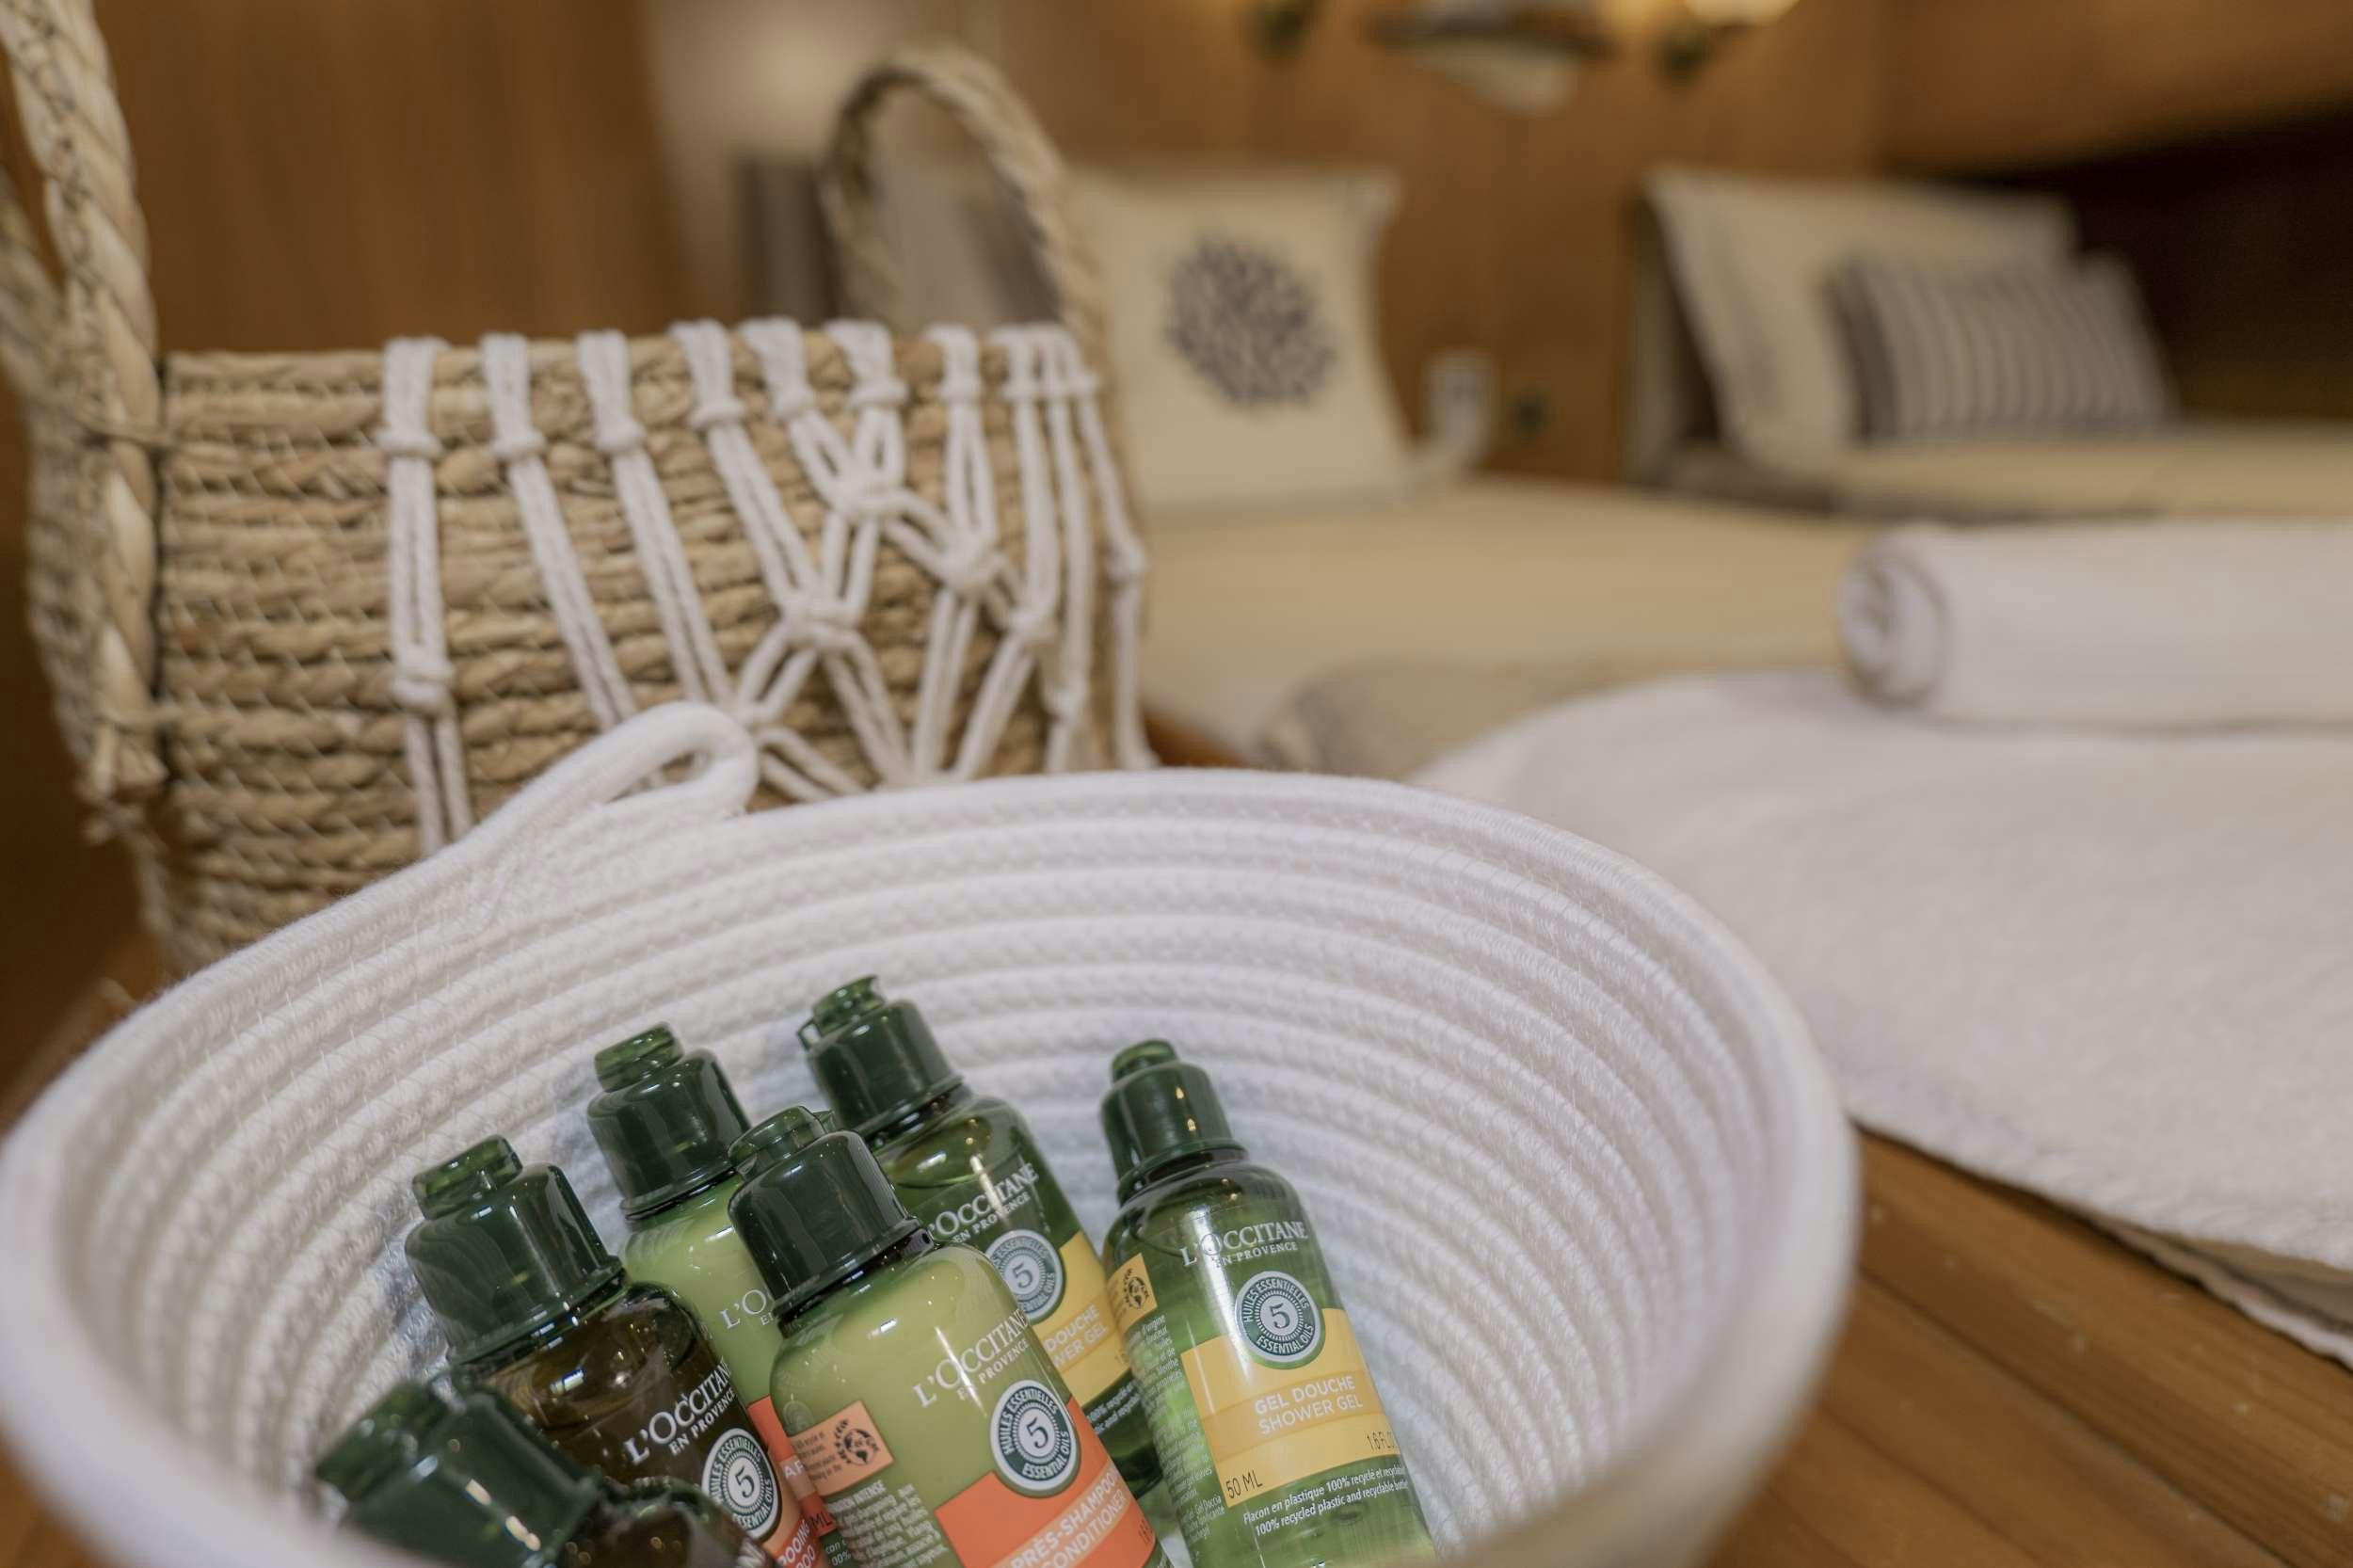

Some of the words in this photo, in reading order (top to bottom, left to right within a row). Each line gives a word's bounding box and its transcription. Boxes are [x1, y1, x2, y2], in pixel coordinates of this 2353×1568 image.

[1180, 1221, 1308, 1267] L'OCCITANE
[1236, 1241, 1299, 1262] PROVENCE
[1012, 1261, 1033, 1288] 5
[1242, 1288, 1259, 1323] HUILES
[1256, 1278, 1310, 1310] ESSENTIELLES
[1268, 1302, 1291, 1330] 5
[1257, 1335, 1304, 1354] ESSENTIAL
[1301, 1322, 1315, 1344] OILS
[912, 1308, 1030, 1407] L'OCCITANE
[978, 1337, 1030, 1384] PROVENCE
[1254, 1393, 1289, 1414] GEL
[1291, 1376, 1356, 1402] DOUCHE
[668, 1433, 690, 1456] EN
[691, 1386, 736, 1438] PROVENCE
[999, 1412, 1014, 1455] HUILES
[1007, 1387, 1059, 1418] ESSENTIELLES
[1026, 1416, 1049, 1449] 5
[1258, 1400, 1335, 1435] SHOWER
[1337, 1394, 1364, 1410] GEL
[718, 1436, 762, 1462] ESSENTIELLES
[1021, 1452, 1068, 1480] ESSENTIAL
[1060, 1431, 1070, 1455] OILS
[734, 1465, 755, 1498] 5
[763, 1478, 773, 1503] OILS
[1225, 1477, 1241, 1499] 50
[1242, 1469, 1264, 1492] ML
[1242, 1506, 1271, 1525] Flacon
[1271, 1500, 1283, 1513] en
[1284, 1485, 1325, 1511] plastique
[1325, 1475, 1351, 1493] 100%
[1351, 1467, 1376, 1485] recyclé
[1255, 1517, 1280, 1537] 100%
[1281, 1503, 1317, 1527] recycled
[1317, 1495, 1347, 1516] plastic
[1346, 1487, 1362, 1504] and
[1362, 1480, 1394, 1498] recyclable
[830, 1550, 852, 1566] 00%
